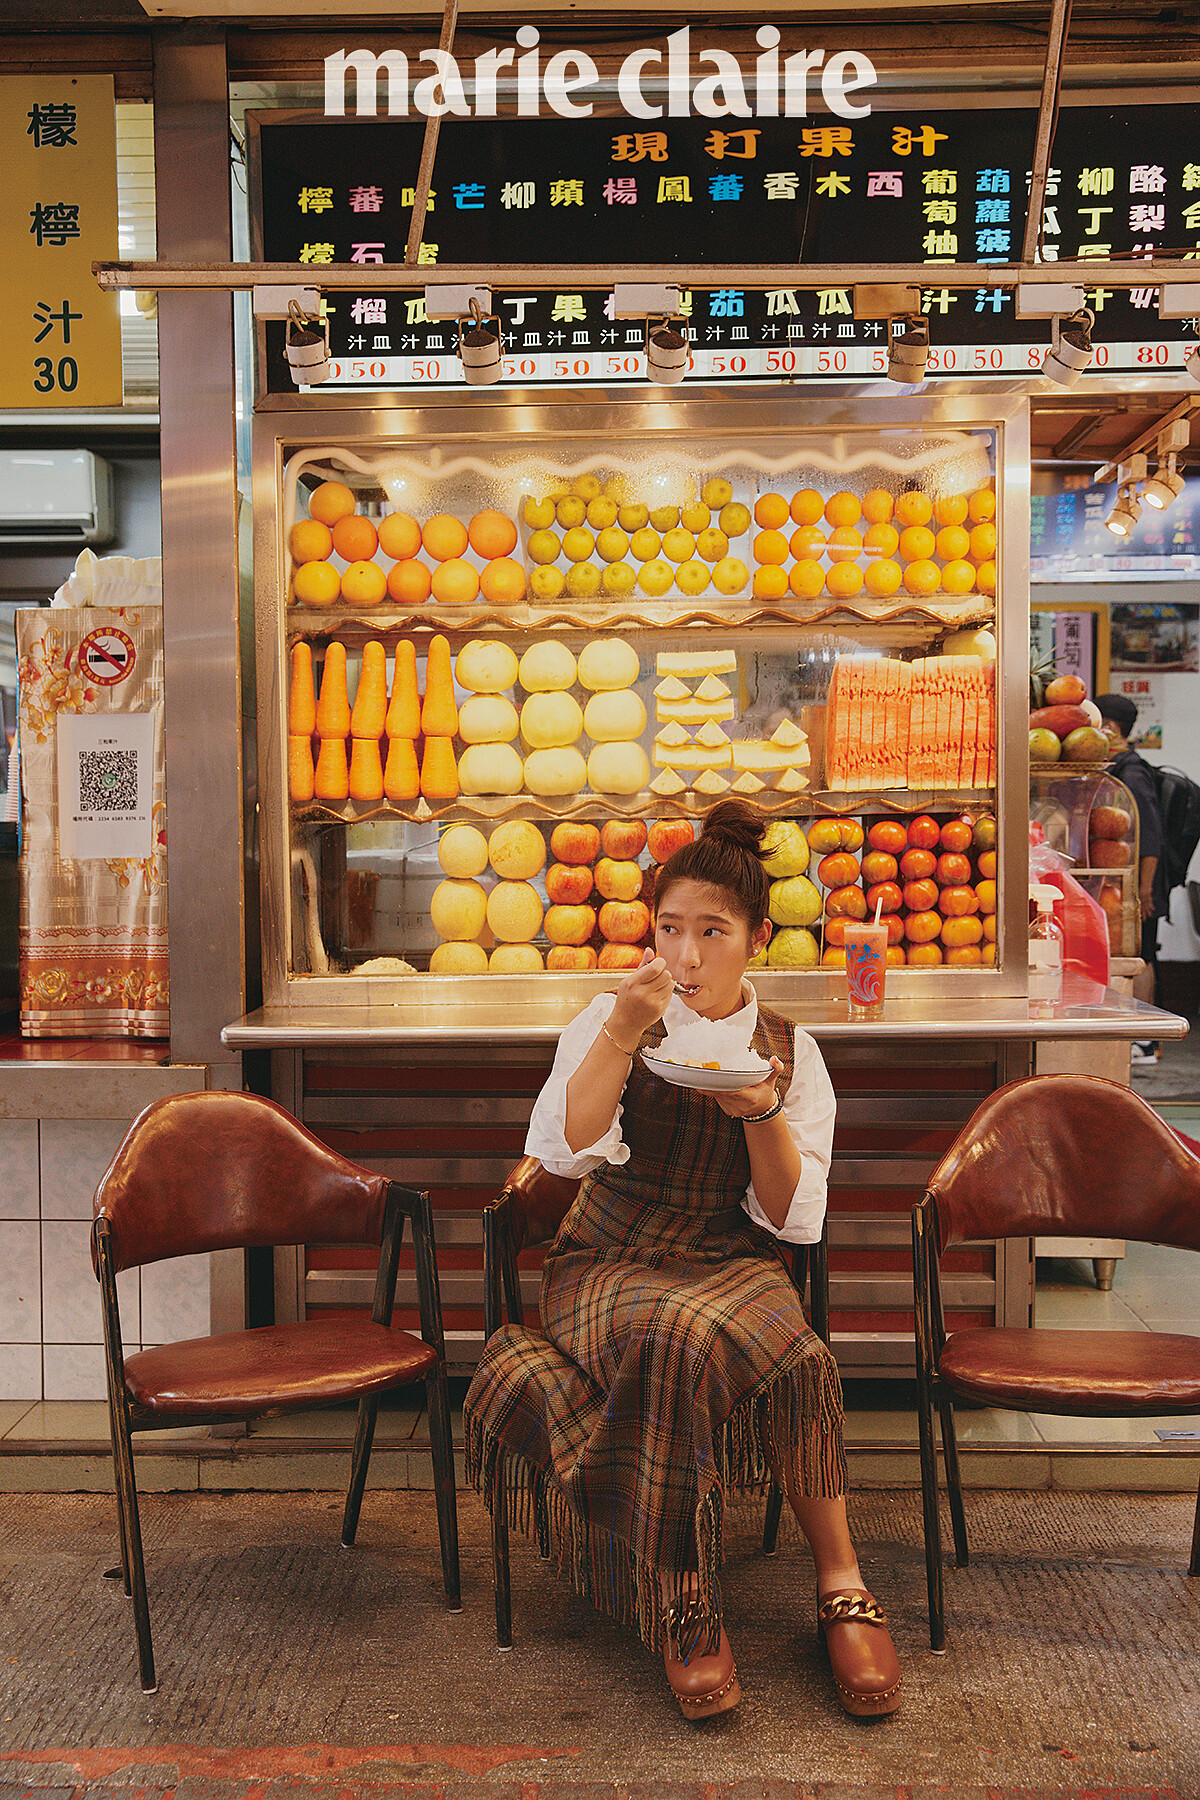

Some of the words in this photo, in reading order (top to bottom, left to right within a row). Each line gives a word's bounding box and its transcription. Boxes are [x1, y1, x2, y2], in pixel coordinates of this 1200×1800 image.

[611, 125, 949, 162] 現打果汁
[921, 170, 958, 314] 葡萄柚汁
[606, 356, 640, 374] 50
[711, 356, 746, 373] 50
[766, 351, 796, 372] 50
[817, 350, 847, 371] 50
[927, 349, 957, 370] 80
[974, 348, 1003, 369] 50
[1137, 345, 1169, 365] 80
[33, 356, 79, 393] 30
[351, 362, 386, 378] 50
[411, 360, 440, 380] 50
[502, 359, 536, 376] 50
[554, 359, 590, 376] 50
